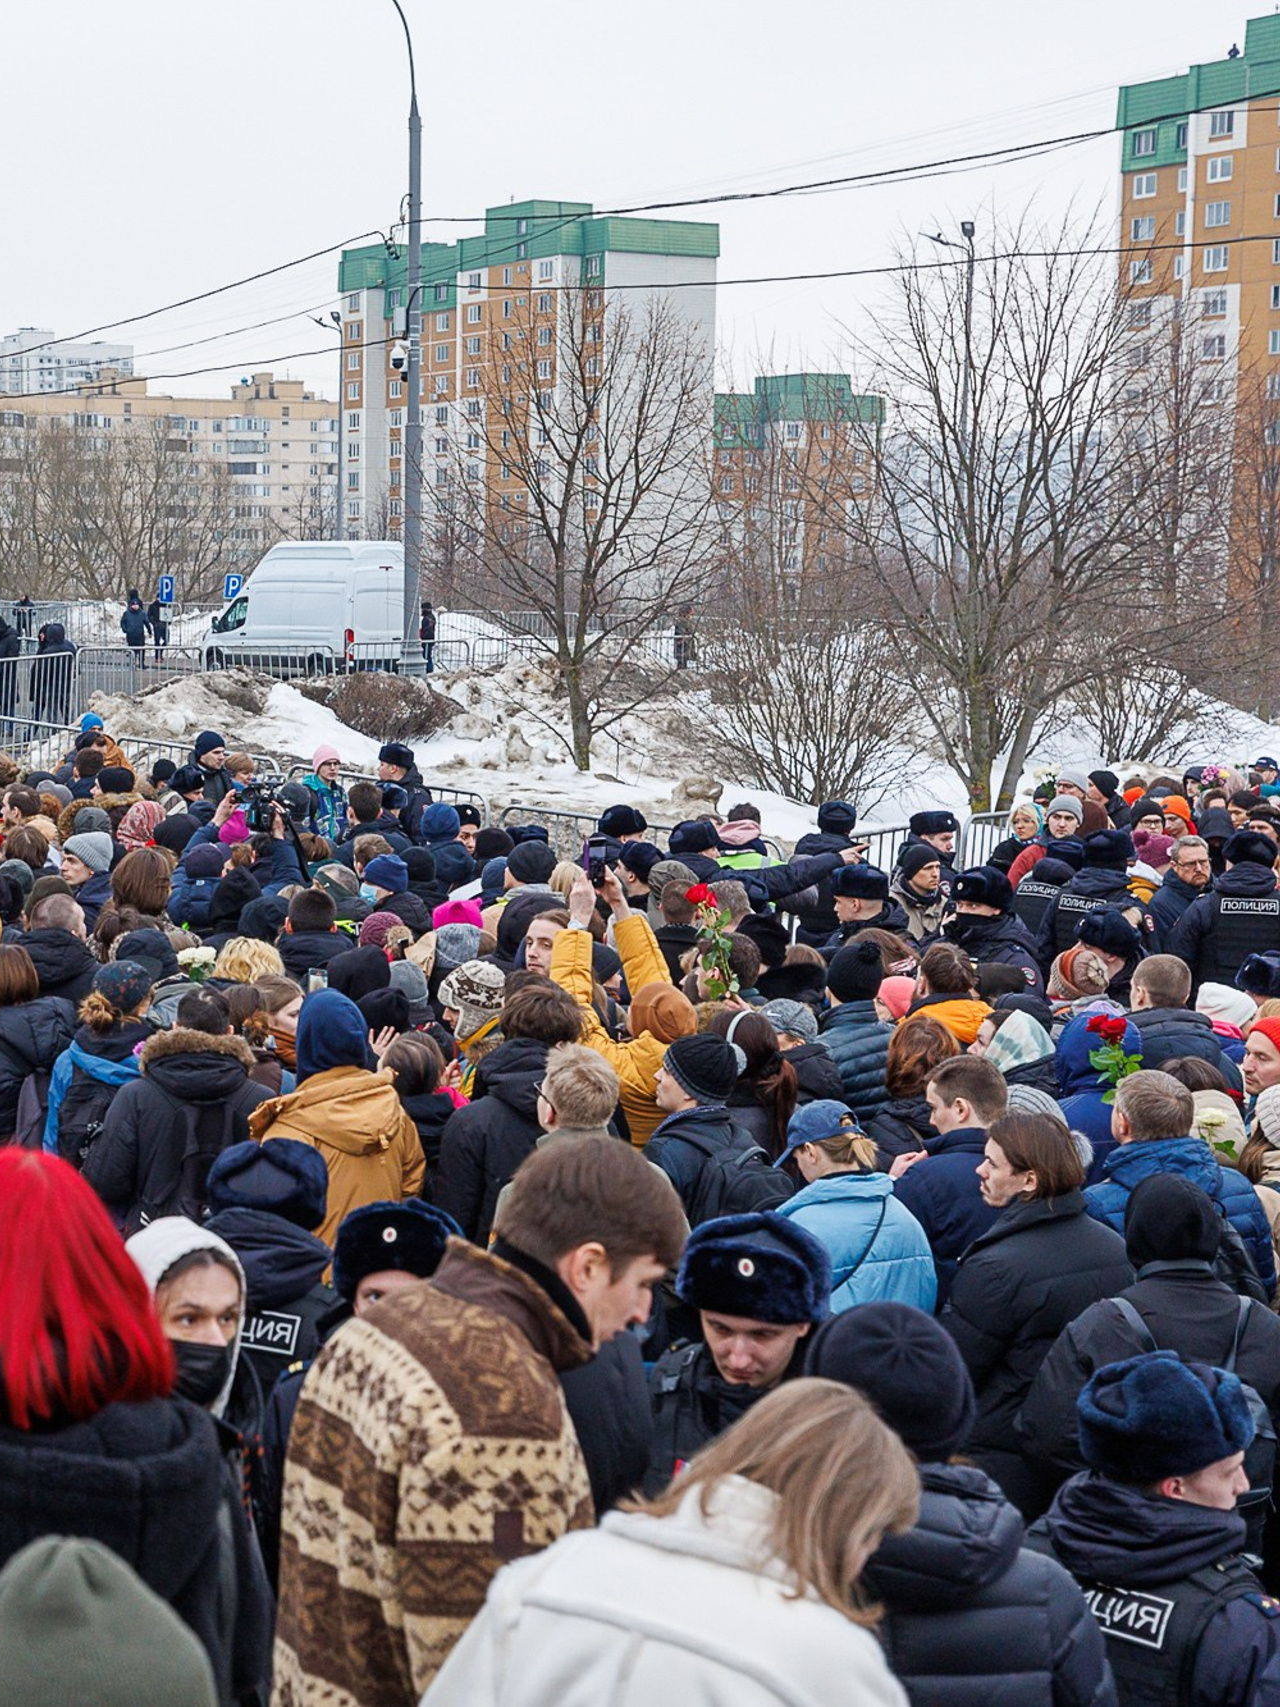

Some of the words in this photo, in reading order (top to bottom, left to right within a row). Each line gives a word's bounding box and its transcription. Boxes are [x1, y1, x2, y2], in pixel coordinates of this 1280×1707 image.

[163, 578, 172, 600] P
[228, 577, 239, 596] P
[1223, 901, 1277, 912] ПОЛИЦИЯ
